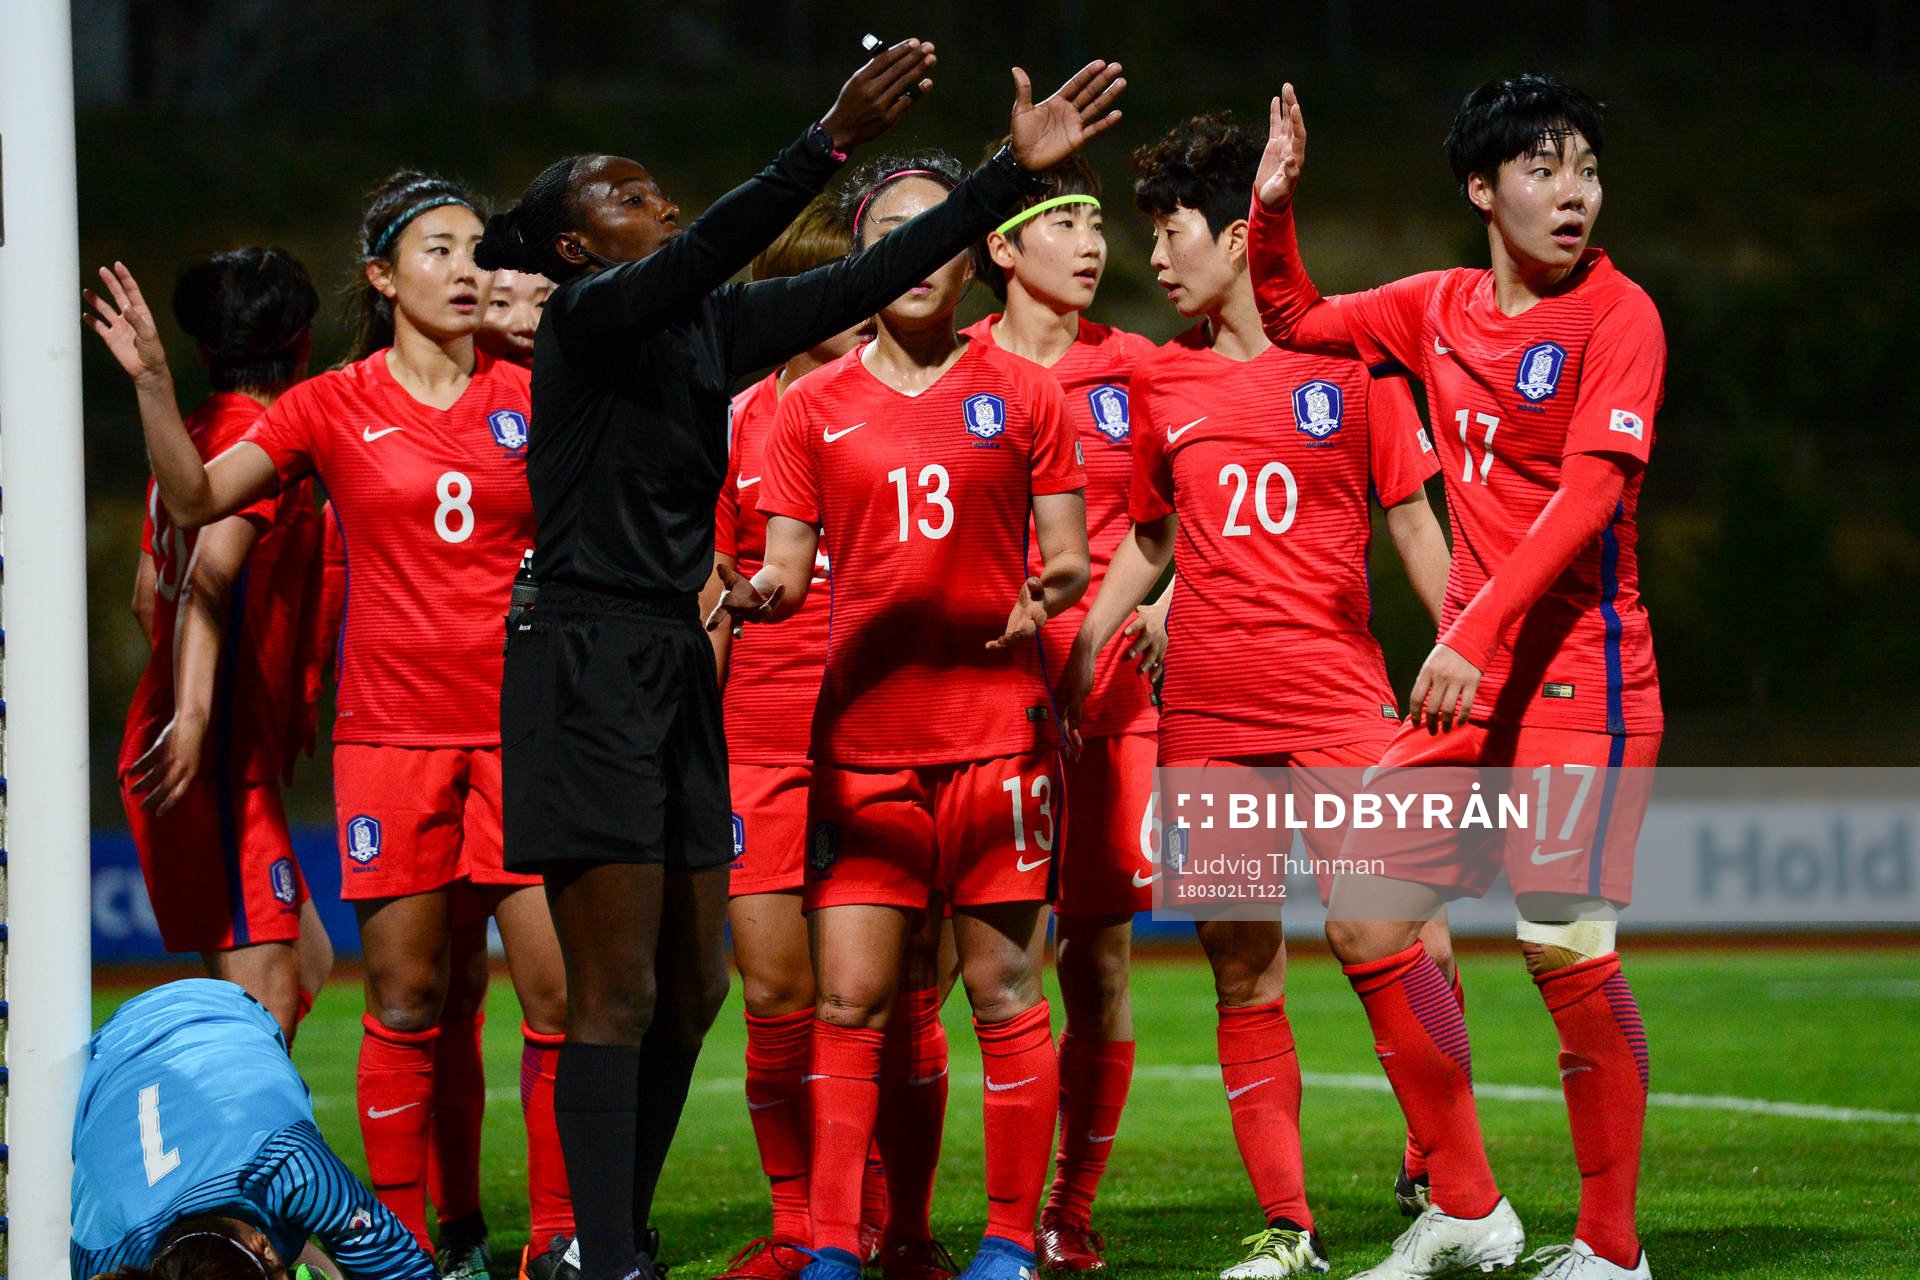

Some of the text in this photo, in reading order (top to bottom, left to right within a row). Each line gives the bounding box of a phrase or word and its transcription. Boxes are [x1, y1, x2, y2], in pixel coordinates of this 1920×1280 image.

[1454, 409, 1500, 485] 17
[434, 471, 475, 544] 8
[888, 464, 955, 542] 13
[1218, 461, 1298, 537] 20
[1002, 774, 1054, 852] 13
[1532, 764, 1597, 840] 17
[1695, 816, 1914, 897] Hold
[138, 1083, 181, 1187] 1
